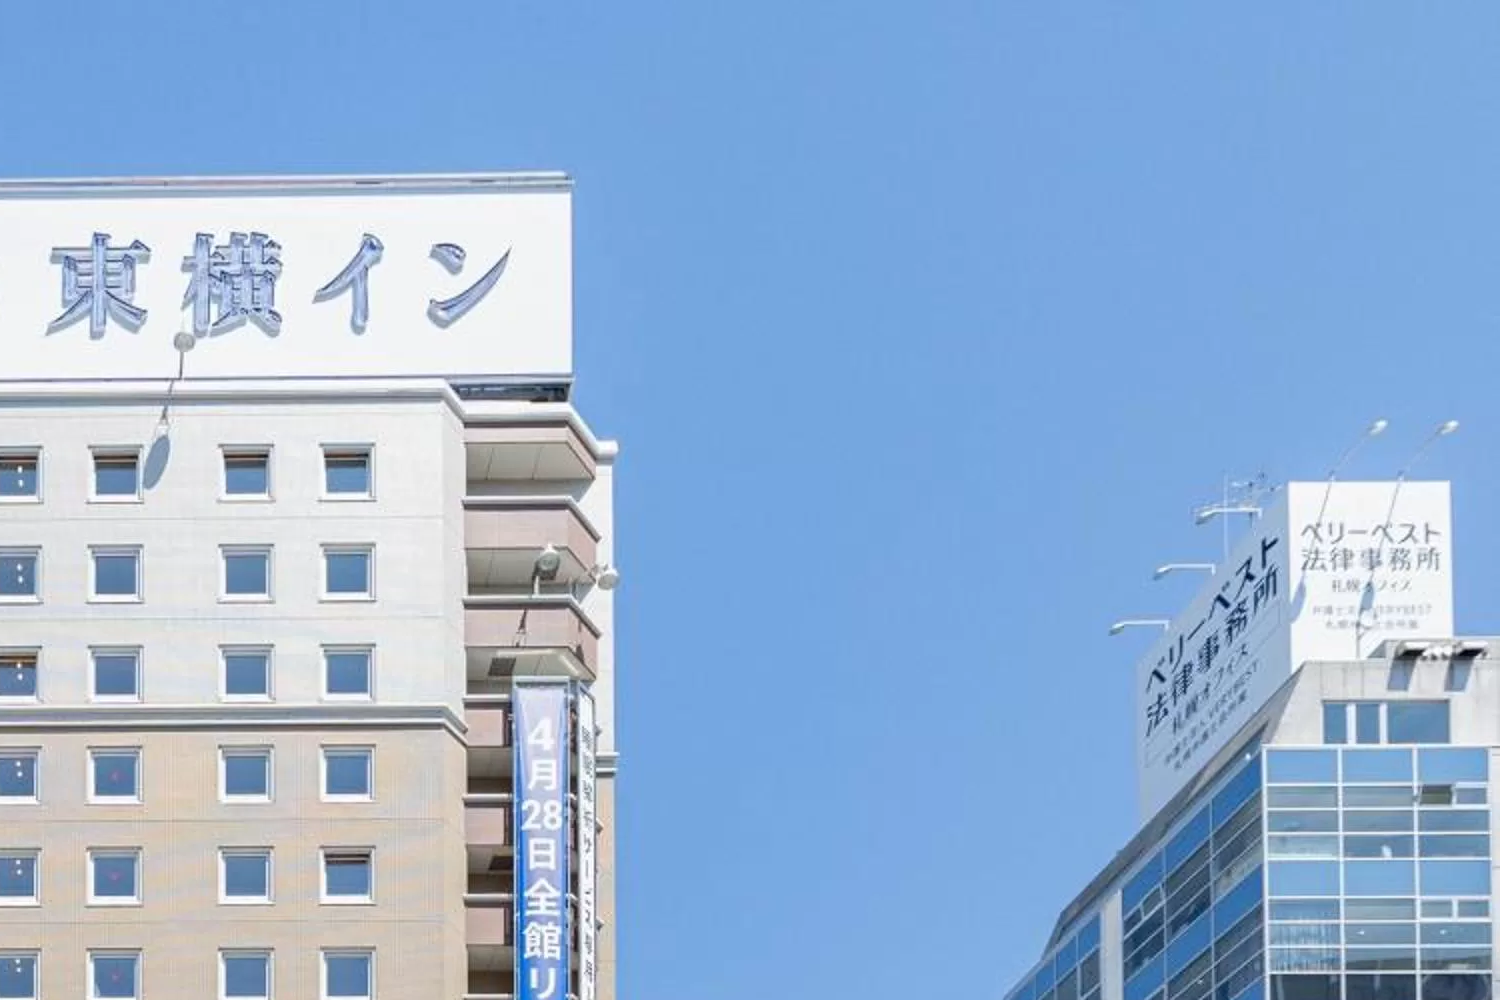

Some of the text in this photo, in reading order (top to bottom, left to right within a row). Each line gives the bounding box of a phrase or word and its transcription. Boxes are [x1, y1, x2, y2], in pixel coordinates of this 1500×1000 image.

[46, 231, 513, 338] 東横イン
[1301, 522, 1441, 546] ベリーベスト
[1301, 547, 1441, 572] 法律事務所
[1146, 537, 1279, 693] ベリーベスト
